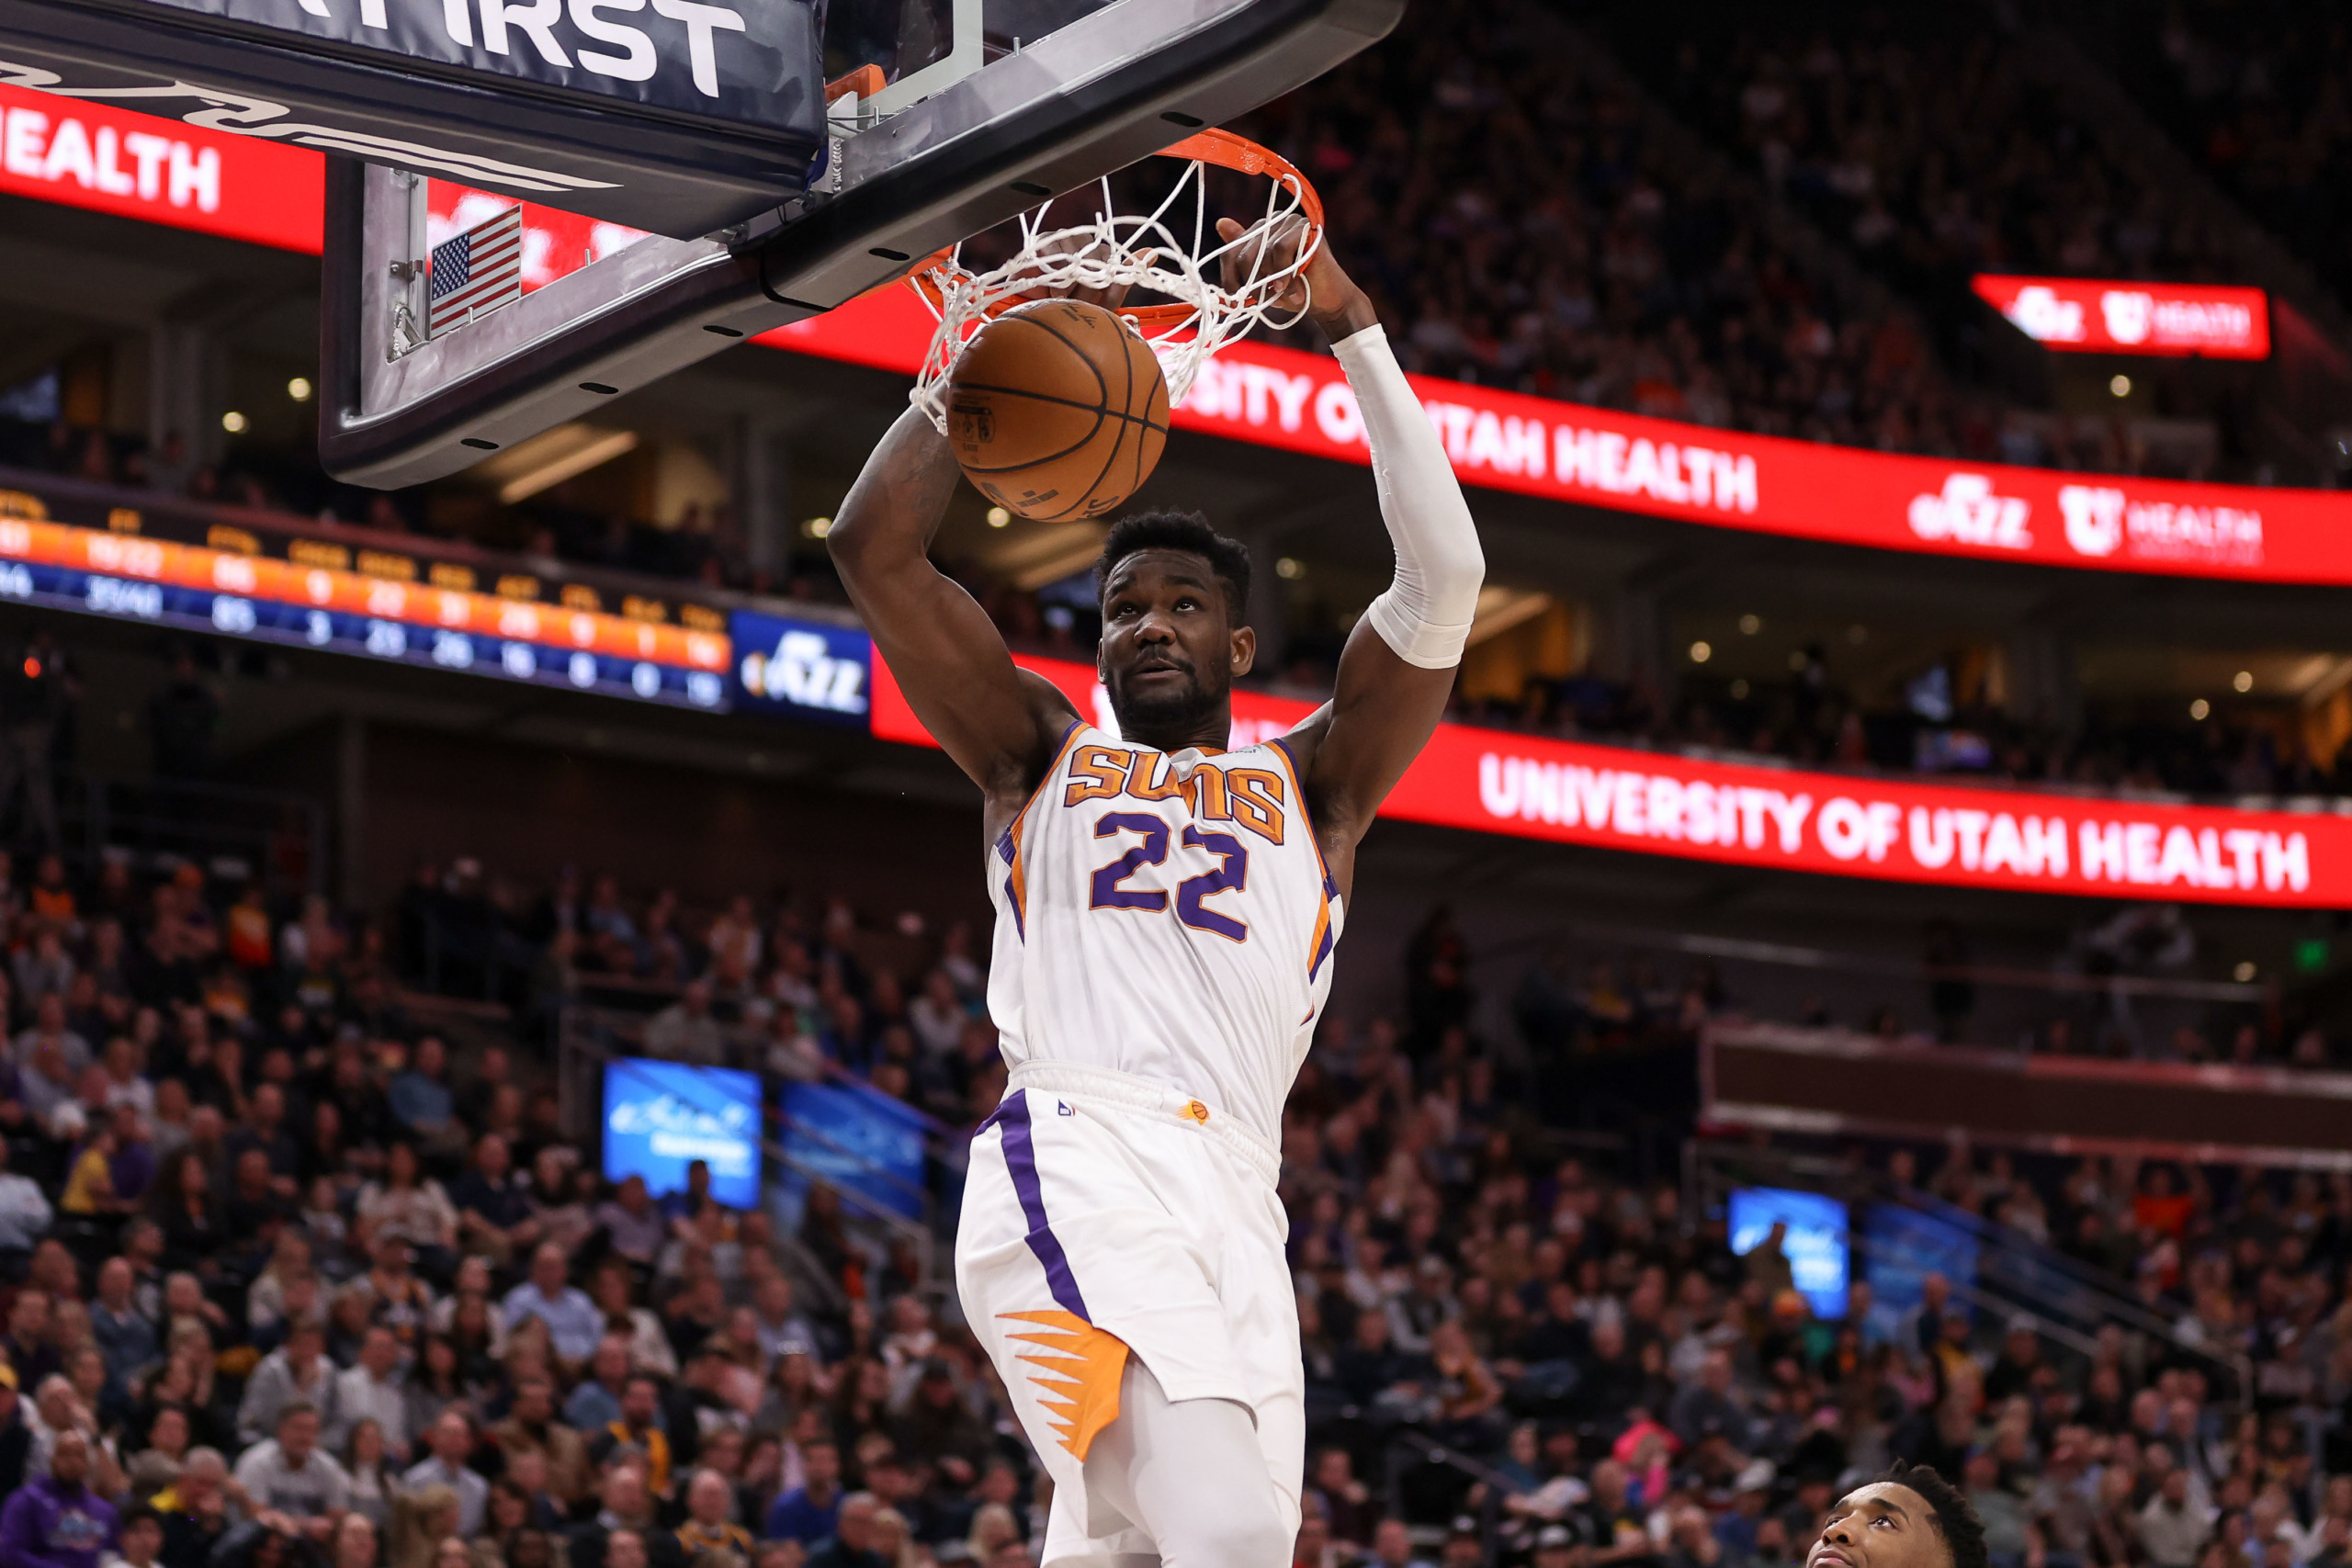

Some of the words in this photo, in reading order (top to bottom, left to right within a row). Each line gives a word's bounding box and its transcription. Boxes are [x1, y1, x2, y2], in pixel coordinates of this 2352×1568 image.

[0, 106, 221, 213] EALTH
[1179, 356, 1314, 434] SITY
[1315, 381, 1370, 448] O
[1554, 423, 1757, 513] HEALTH
[2126, 499, 2262, 550] HEALTH
[1064, 745, 1284, 846] SUNS
[1479, 752, 1813, 854] UNIVERSITY
[1818, 797, 1902, 863] OF
[1908, 806, 2069, 878] UTAH
[2078, 818, 2310, 893] HEALTH
[1089, 811, 1249, 943] 22
